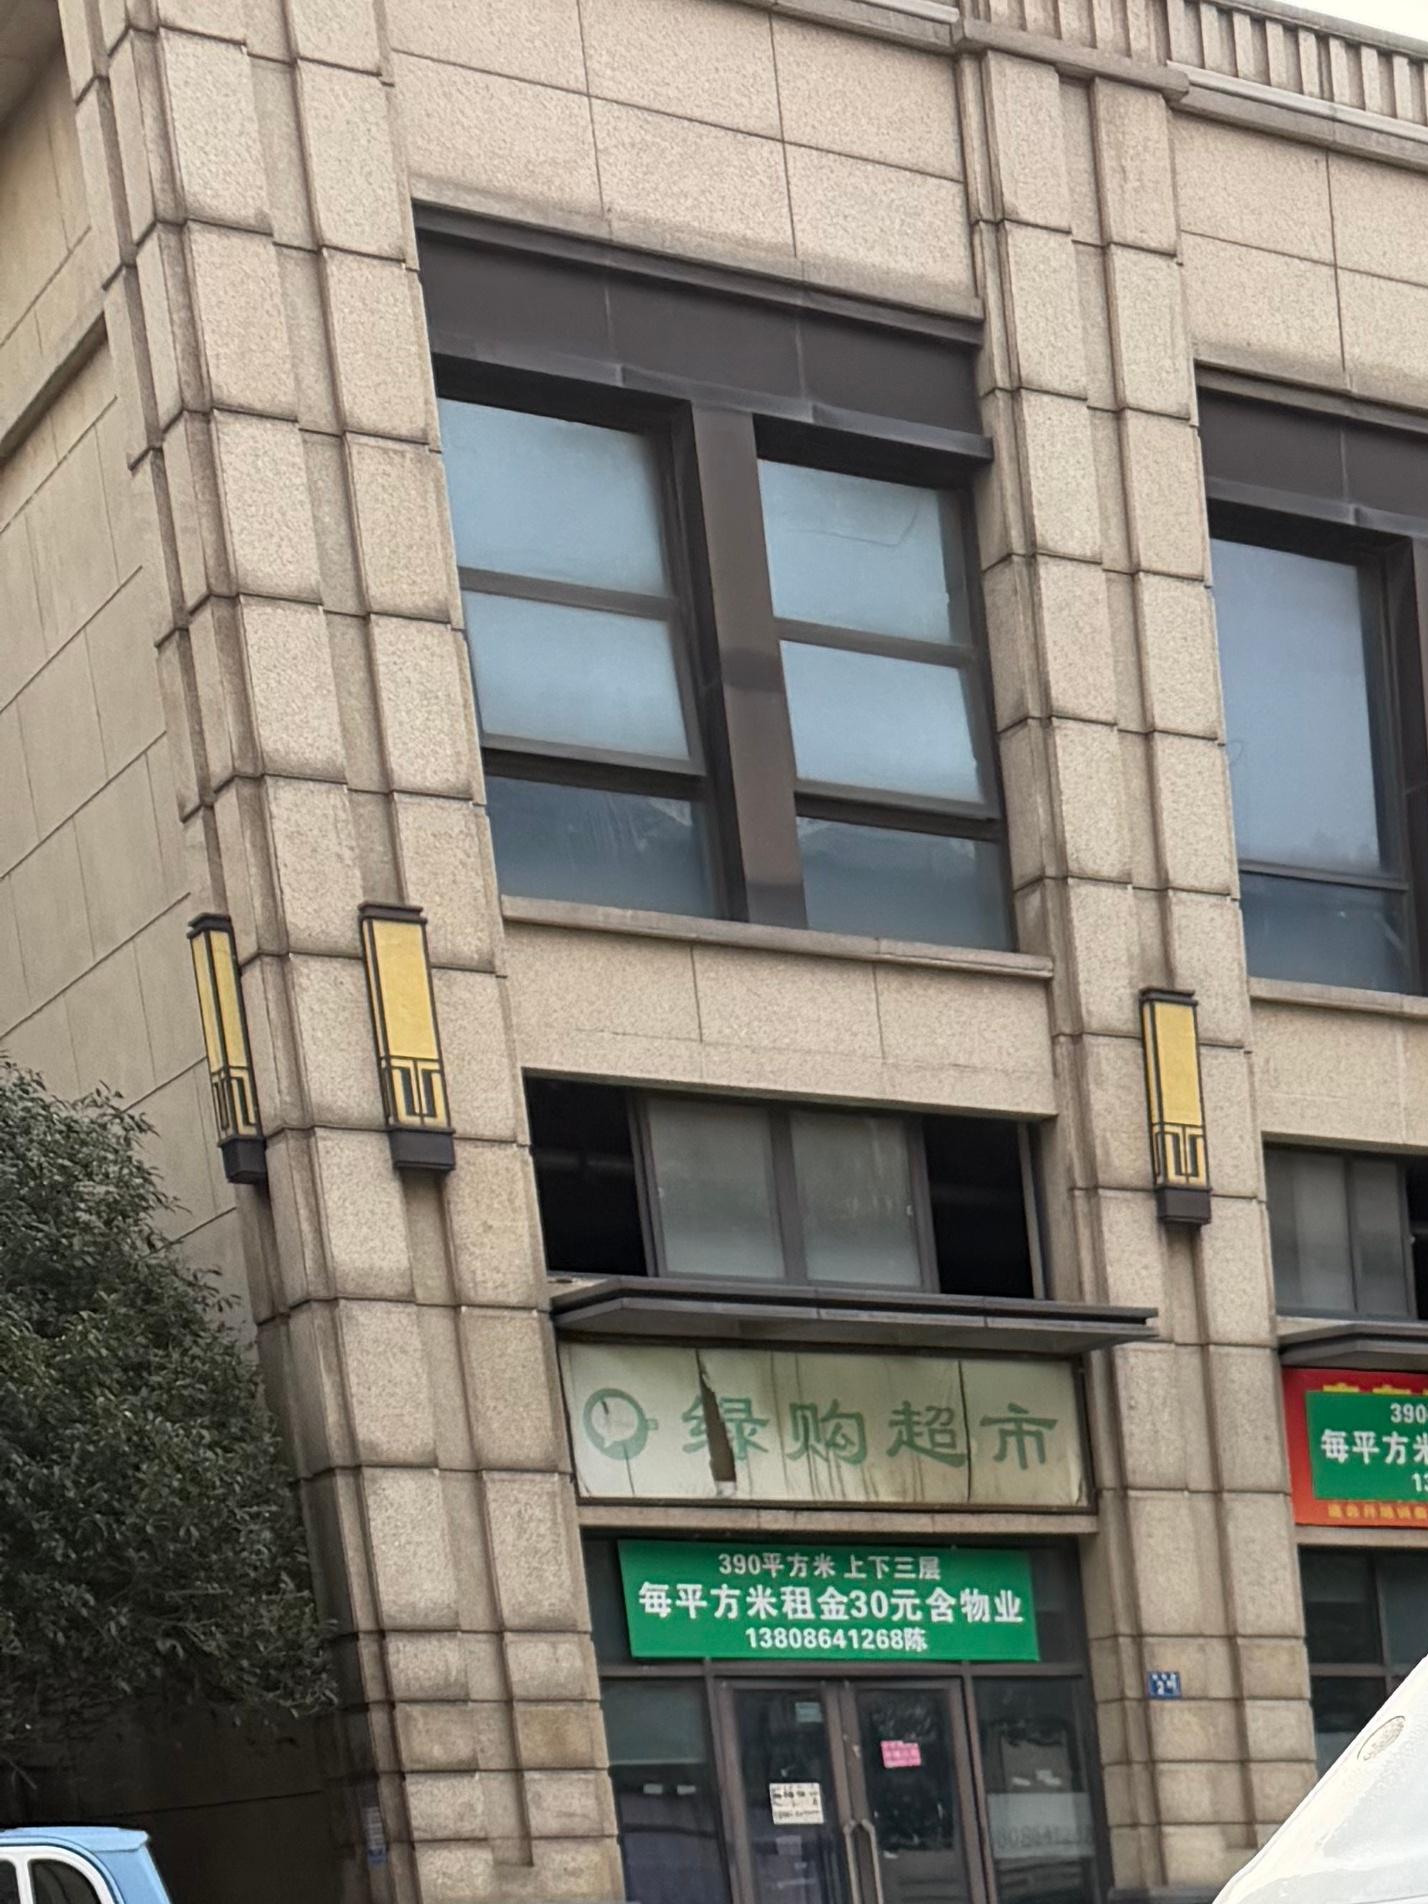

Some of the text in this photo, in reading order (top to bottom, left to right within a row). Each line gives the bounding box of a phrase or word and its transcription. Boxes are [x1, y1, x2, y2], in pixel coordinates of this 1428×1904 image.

[681, 1395, 1058, 1470] 绿购超市
[718, 1553, 943, 1580] 390平方米 上下三层
[638, 1581, 1024, 1624] 每平方米租金30元含物业
[744, 1627, 928, 1652] 13808641268陈
